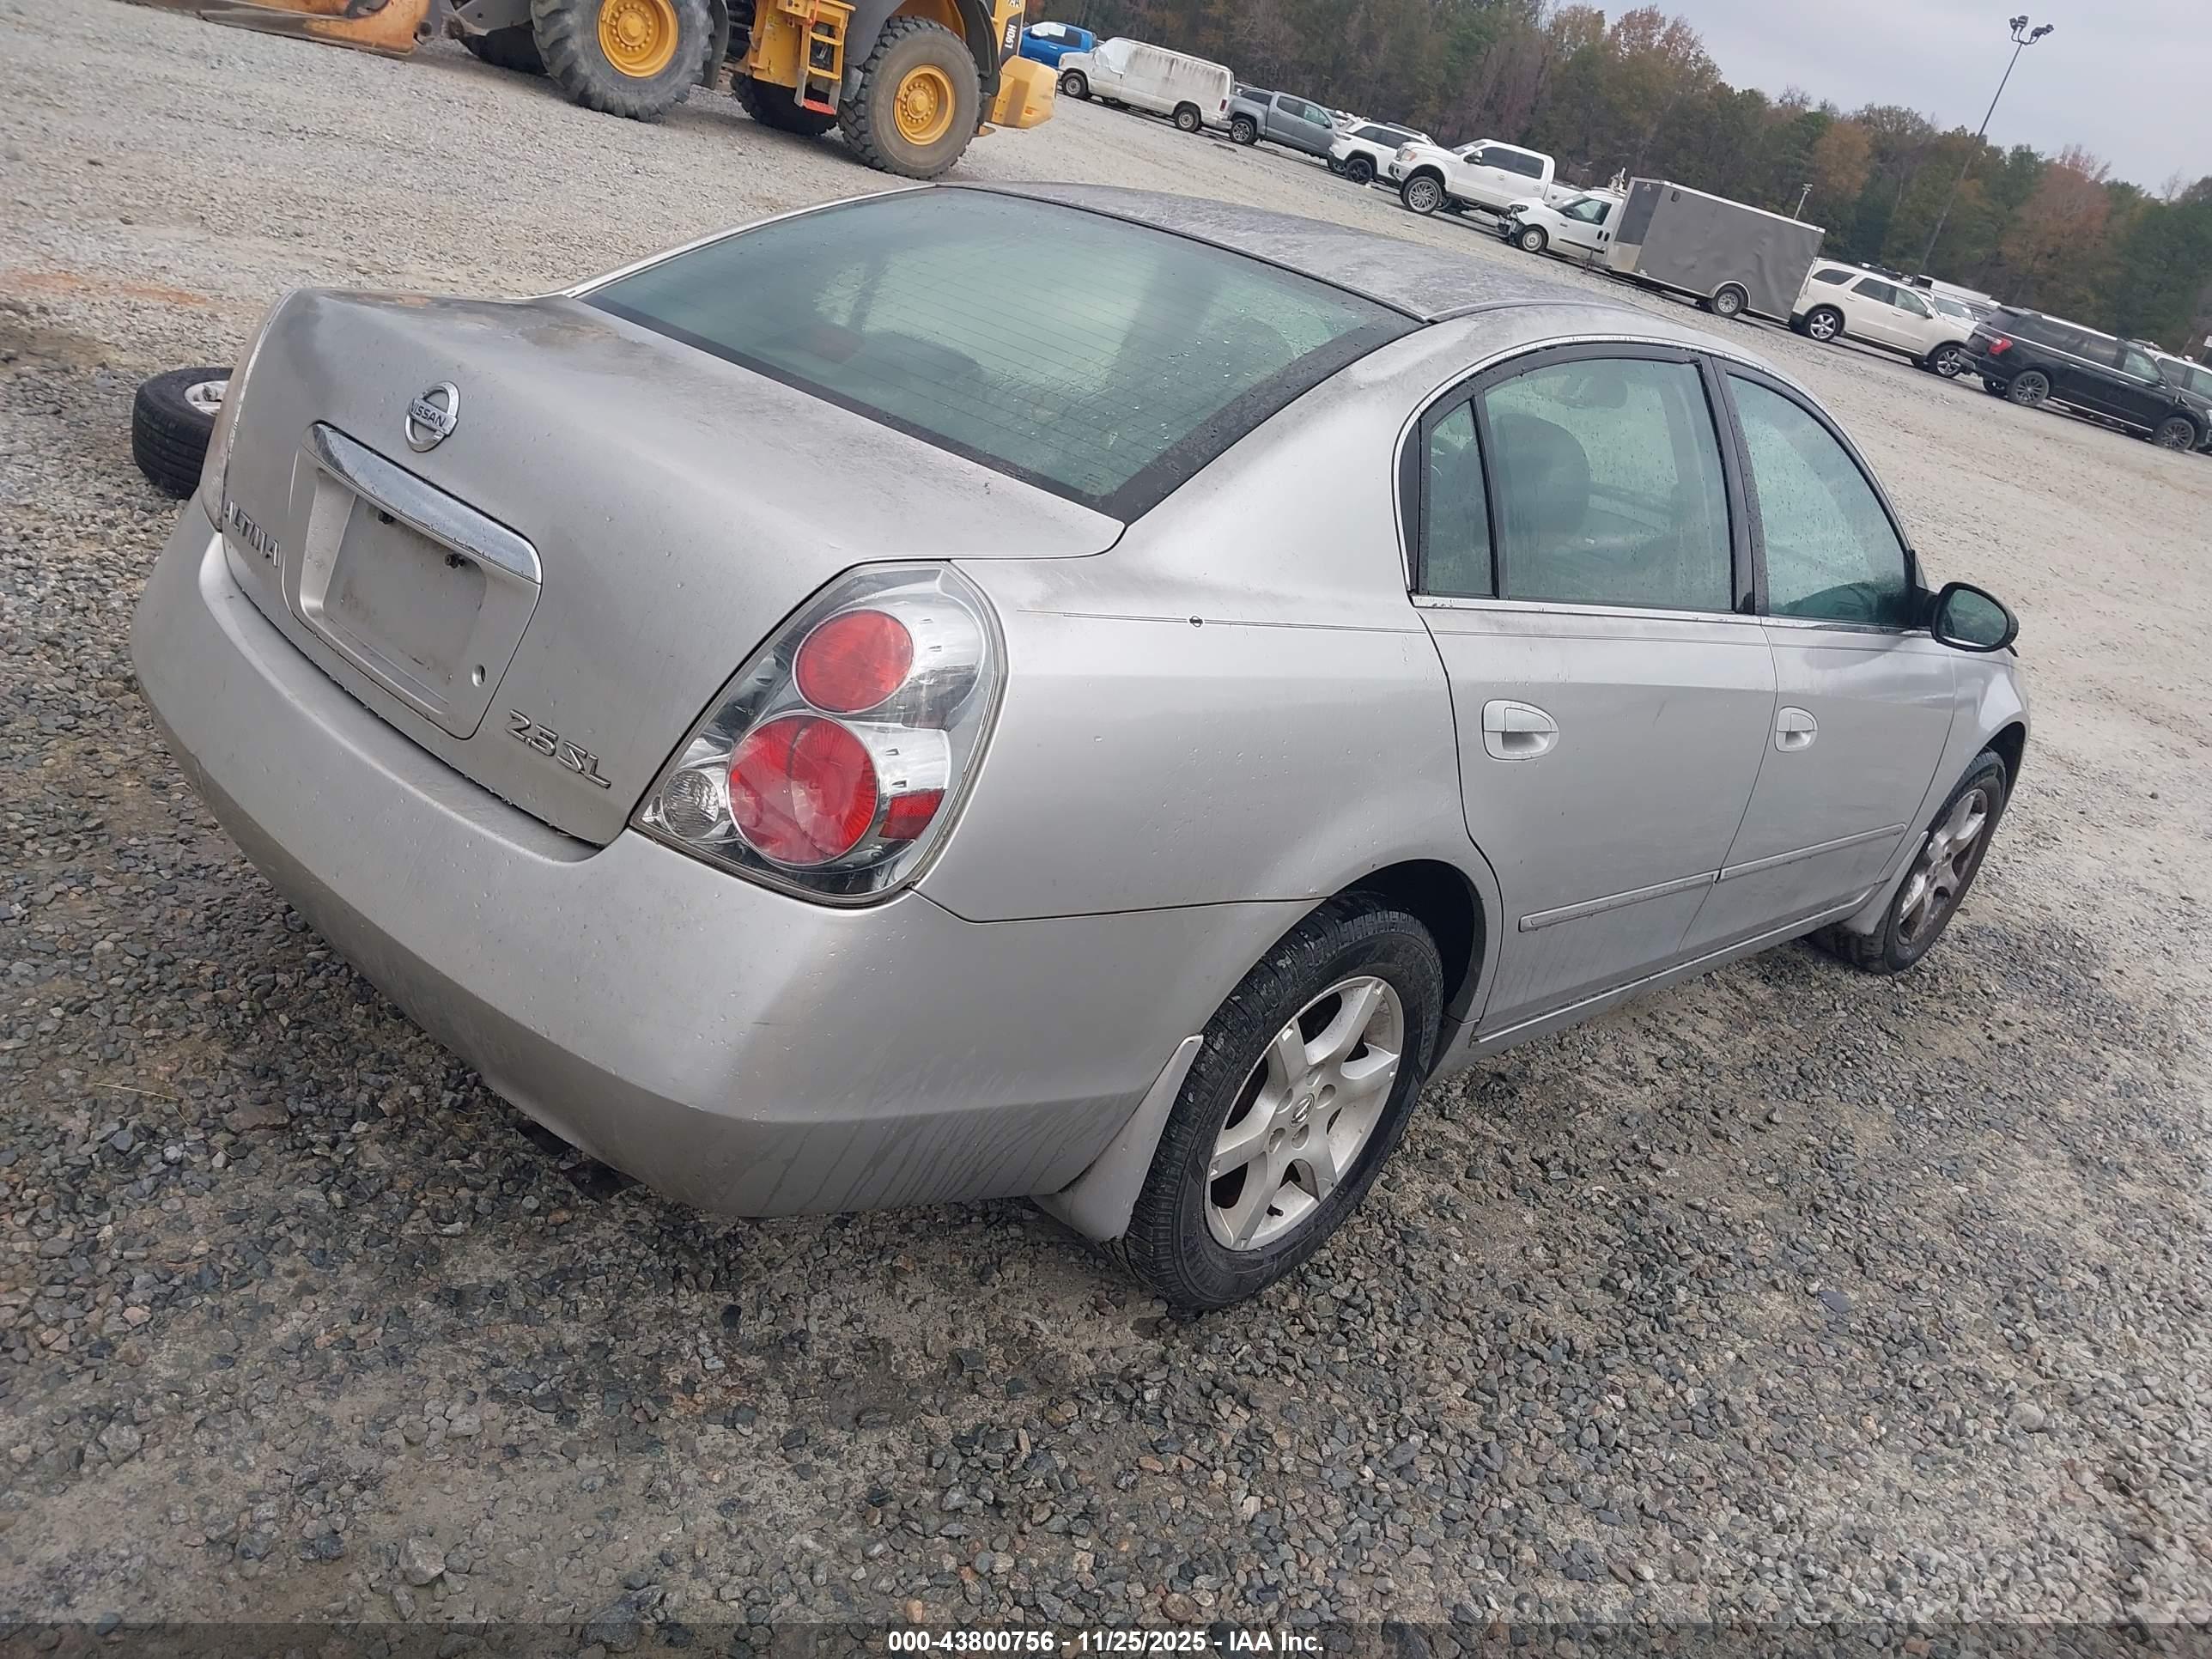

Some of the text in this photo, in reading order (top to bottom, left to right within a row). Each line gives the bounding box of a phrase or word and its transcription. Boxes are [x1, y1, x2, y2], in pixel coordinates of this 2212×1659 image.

[1004, 23, 1018, 49] L90H
[410, 398, 447, 428] NISSAN
[224, 500, 280, 568] ALTIMA
